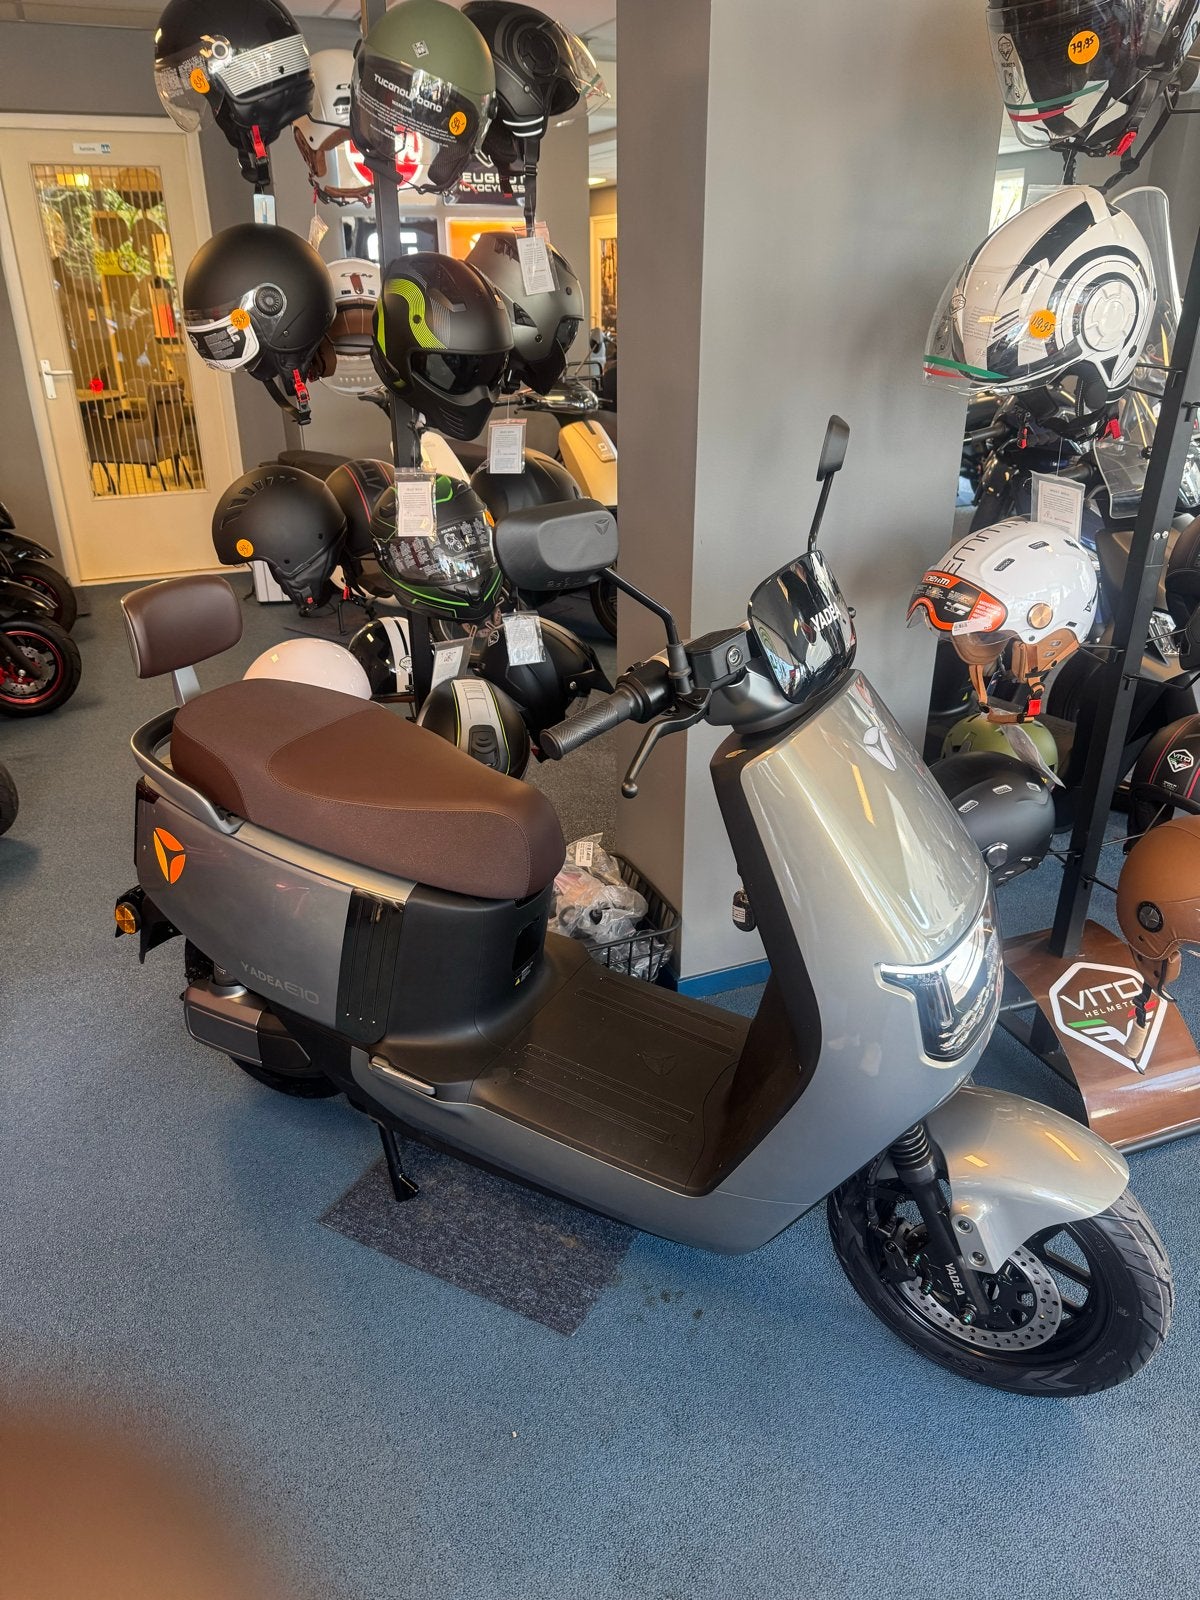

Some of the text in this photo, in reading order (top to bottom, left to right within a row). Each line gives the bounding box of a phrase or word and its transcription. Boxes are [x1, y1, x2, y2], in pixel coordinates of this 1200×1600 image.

[240, 959, 284, 991] YADEA
[1059, 977, 1143, 1011] VITO
[944, 1262, 966, 1297] YADEA
